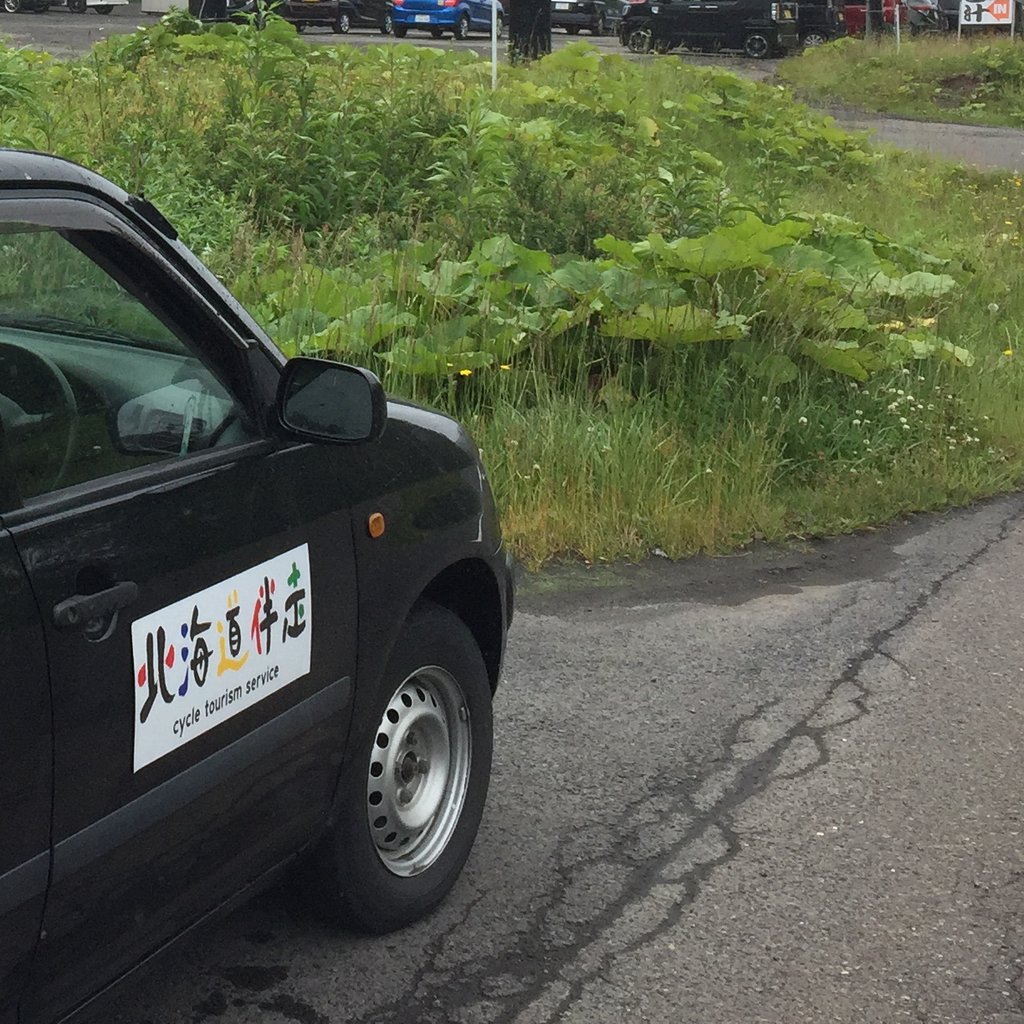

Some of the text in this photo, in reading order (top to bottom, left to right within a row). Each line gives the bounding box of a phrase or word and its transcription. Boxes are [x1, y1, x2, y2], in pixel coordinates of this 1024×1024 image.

[993, 3, 1008, 15] IN
[172, 663, 280, 738] cycle tourism service
